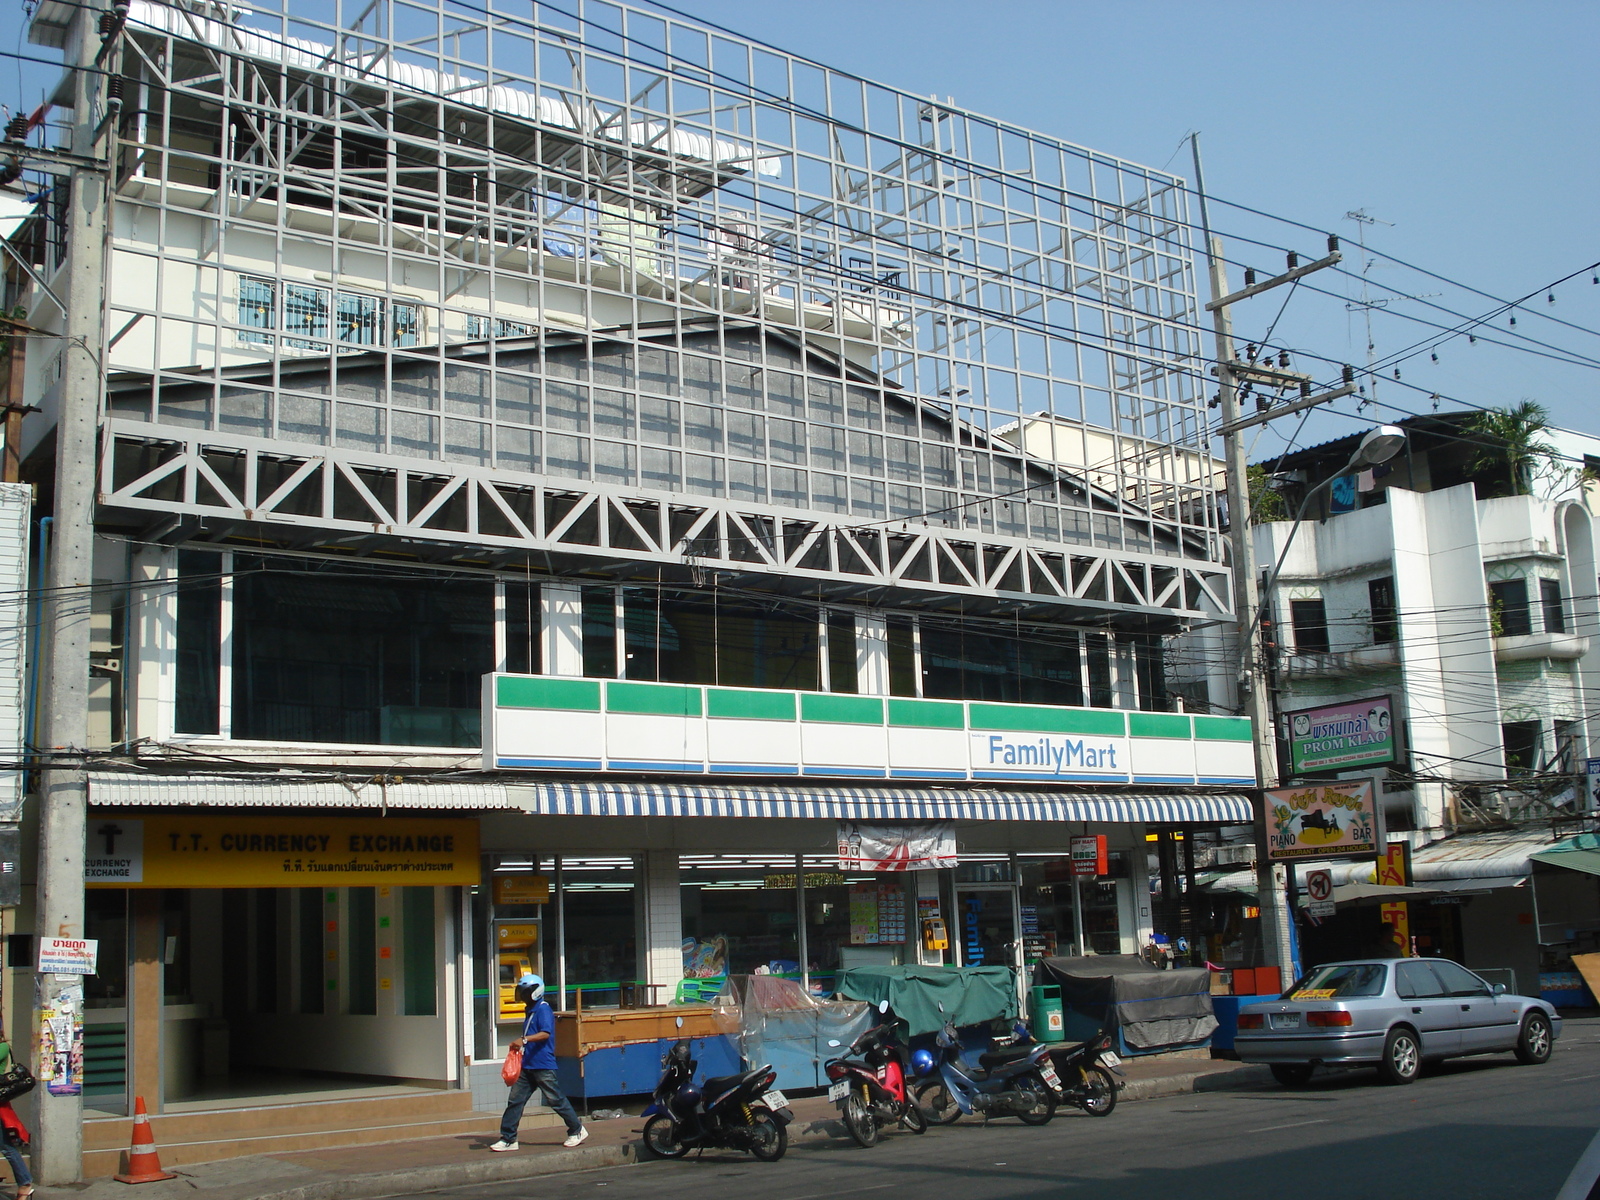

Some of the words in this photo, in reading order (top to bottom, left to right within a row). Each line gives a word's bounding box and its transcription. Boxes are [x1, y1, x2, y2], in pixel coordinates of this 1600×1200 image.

[1313, 714, 1369, 739] พรหมเกล้า
[1303, 738, 1344, 755] PROM
[1347, 730, 1388, 748] KLAO
[989, 735, 1117, 775] FamilyMart
[1274, 804, 1291, 824] Le
[1289, 788, 1317, 811] Café
[1321, 786, 1363, 811] Royale
[1270, 833, 1296, 847] PIANO
[1352, 827, 1372, 841] BAR
[168, 833, 209, 852] T.T.
[220, 834, 330, 852] CURRENCY
[349, 834, 455, 852] EXCHANGE
[1274, 848, 1315, 857] RESTAURANT
[1346, 844, 1371, 852] HOURS
[84, 859, 131, 868] CURRENCY
[307, 857, 454, 873] รับแลกเปลี่ยนเงินตราต่างประเทศ
[85, 868, 130, 877] EXCHANGE
[52, 939, 86, 951] ขายถูก
